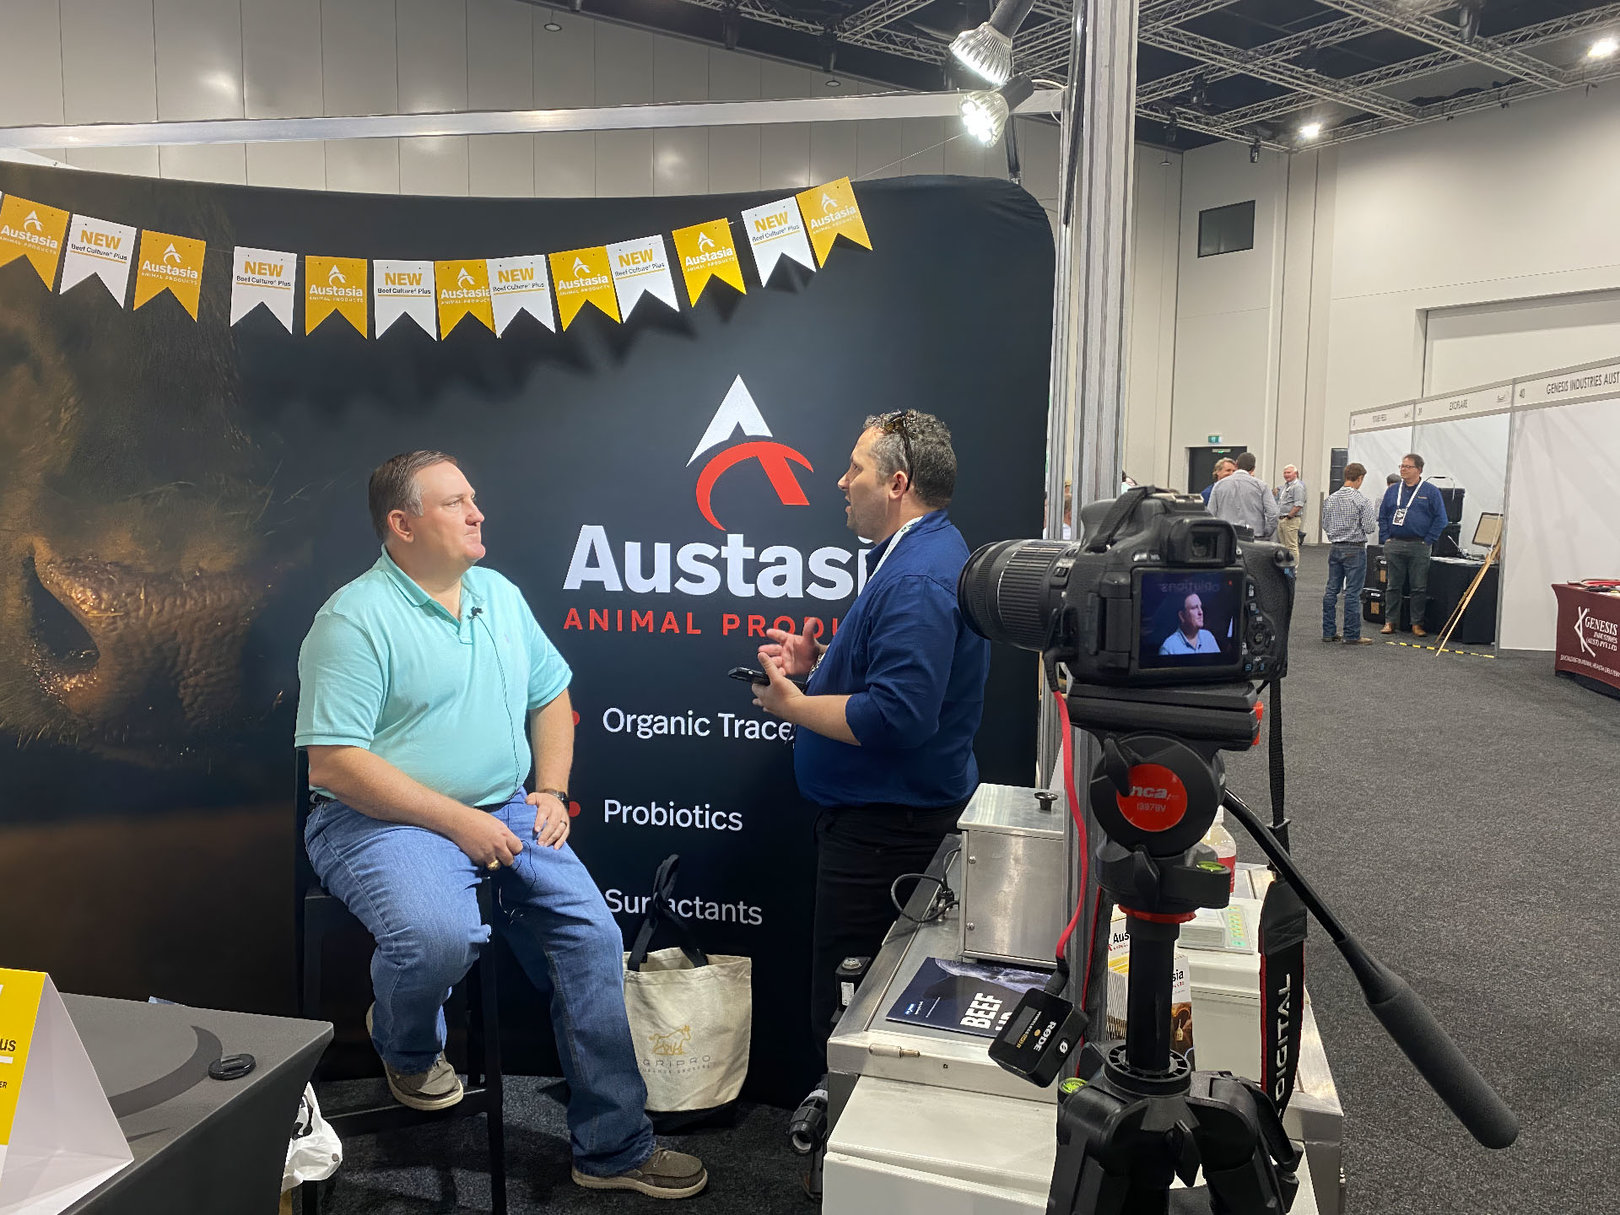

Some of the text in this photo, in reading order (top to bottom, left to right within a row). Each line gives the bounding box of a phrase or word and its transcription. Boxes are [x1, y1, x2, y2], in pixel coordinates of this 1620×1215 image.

[754, 212, 788, 231] NEW
[810, 206, 856, 230] Austasia
[1, 225, 58, 248] Austasia
[80, 230, 122, 250] NEW
[619, 249, 653, 268] NEW
[685, 247, 733, 267] Austasia
[142, 260, 198, 278] Austasia
[244, 261, 284, 277] NEW
[385, 272, 422, 285] NEW
[498, 268, 534, 284] NEW
[310, 284, 362, 297] Austasia
[558, 274, 608, 290] Austasia
[1546, 380, 1568, 394] GENESIS
[1570, 375, 1602, 390] INDUSTRIES
[563, 524, 873, 600] Austasi
[564, 608, 702, 634] ANIMAL
[1585, 616, 1618, 636] GENESIS
[602, 707, 795, 742] Organic Trace
[1130, 786, 1167, 799] nca
[604, 799, 743, 831] Probiotics
[604, 888, 763, 925] Suractants
[960, 992, 1003, 1029] BEEF
[1276, 973, 1290, 1101] DIGITAL
[643, 1055, 710, 1067] GRIPRO
